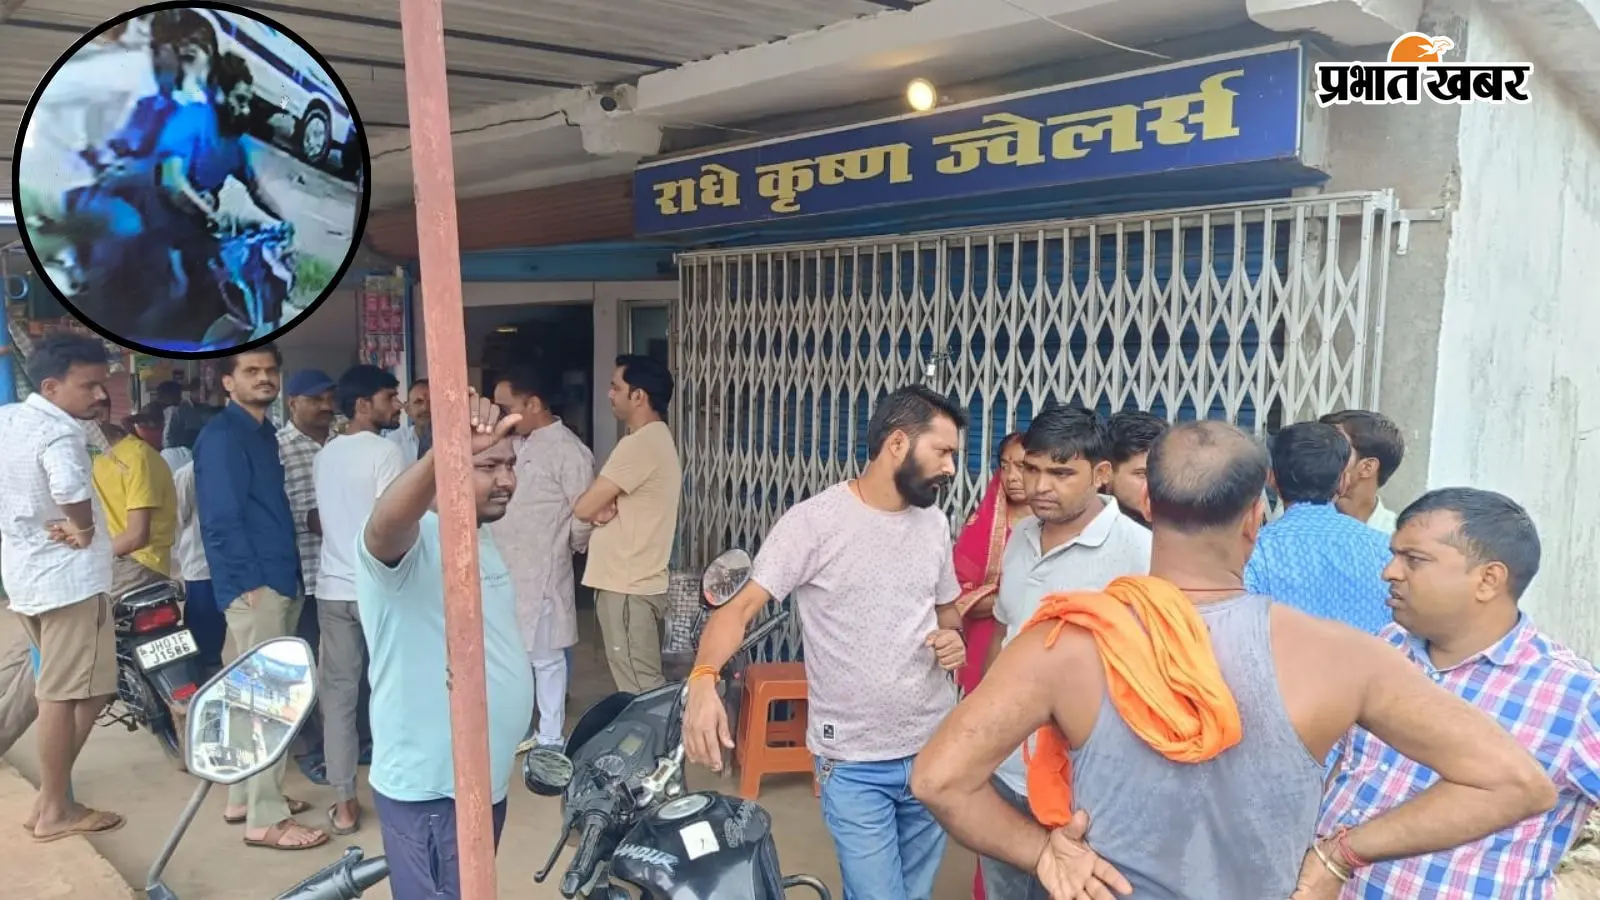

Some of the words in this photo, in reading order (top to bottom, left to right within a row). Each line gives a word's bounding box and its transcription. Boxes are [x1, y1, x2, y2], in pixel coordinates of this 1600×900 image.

[653, 164, 741, 216] राधे
[755, 142, 912, 213] कृष्ण
[932, 68, 1245, 175] ज्वेलर्स
